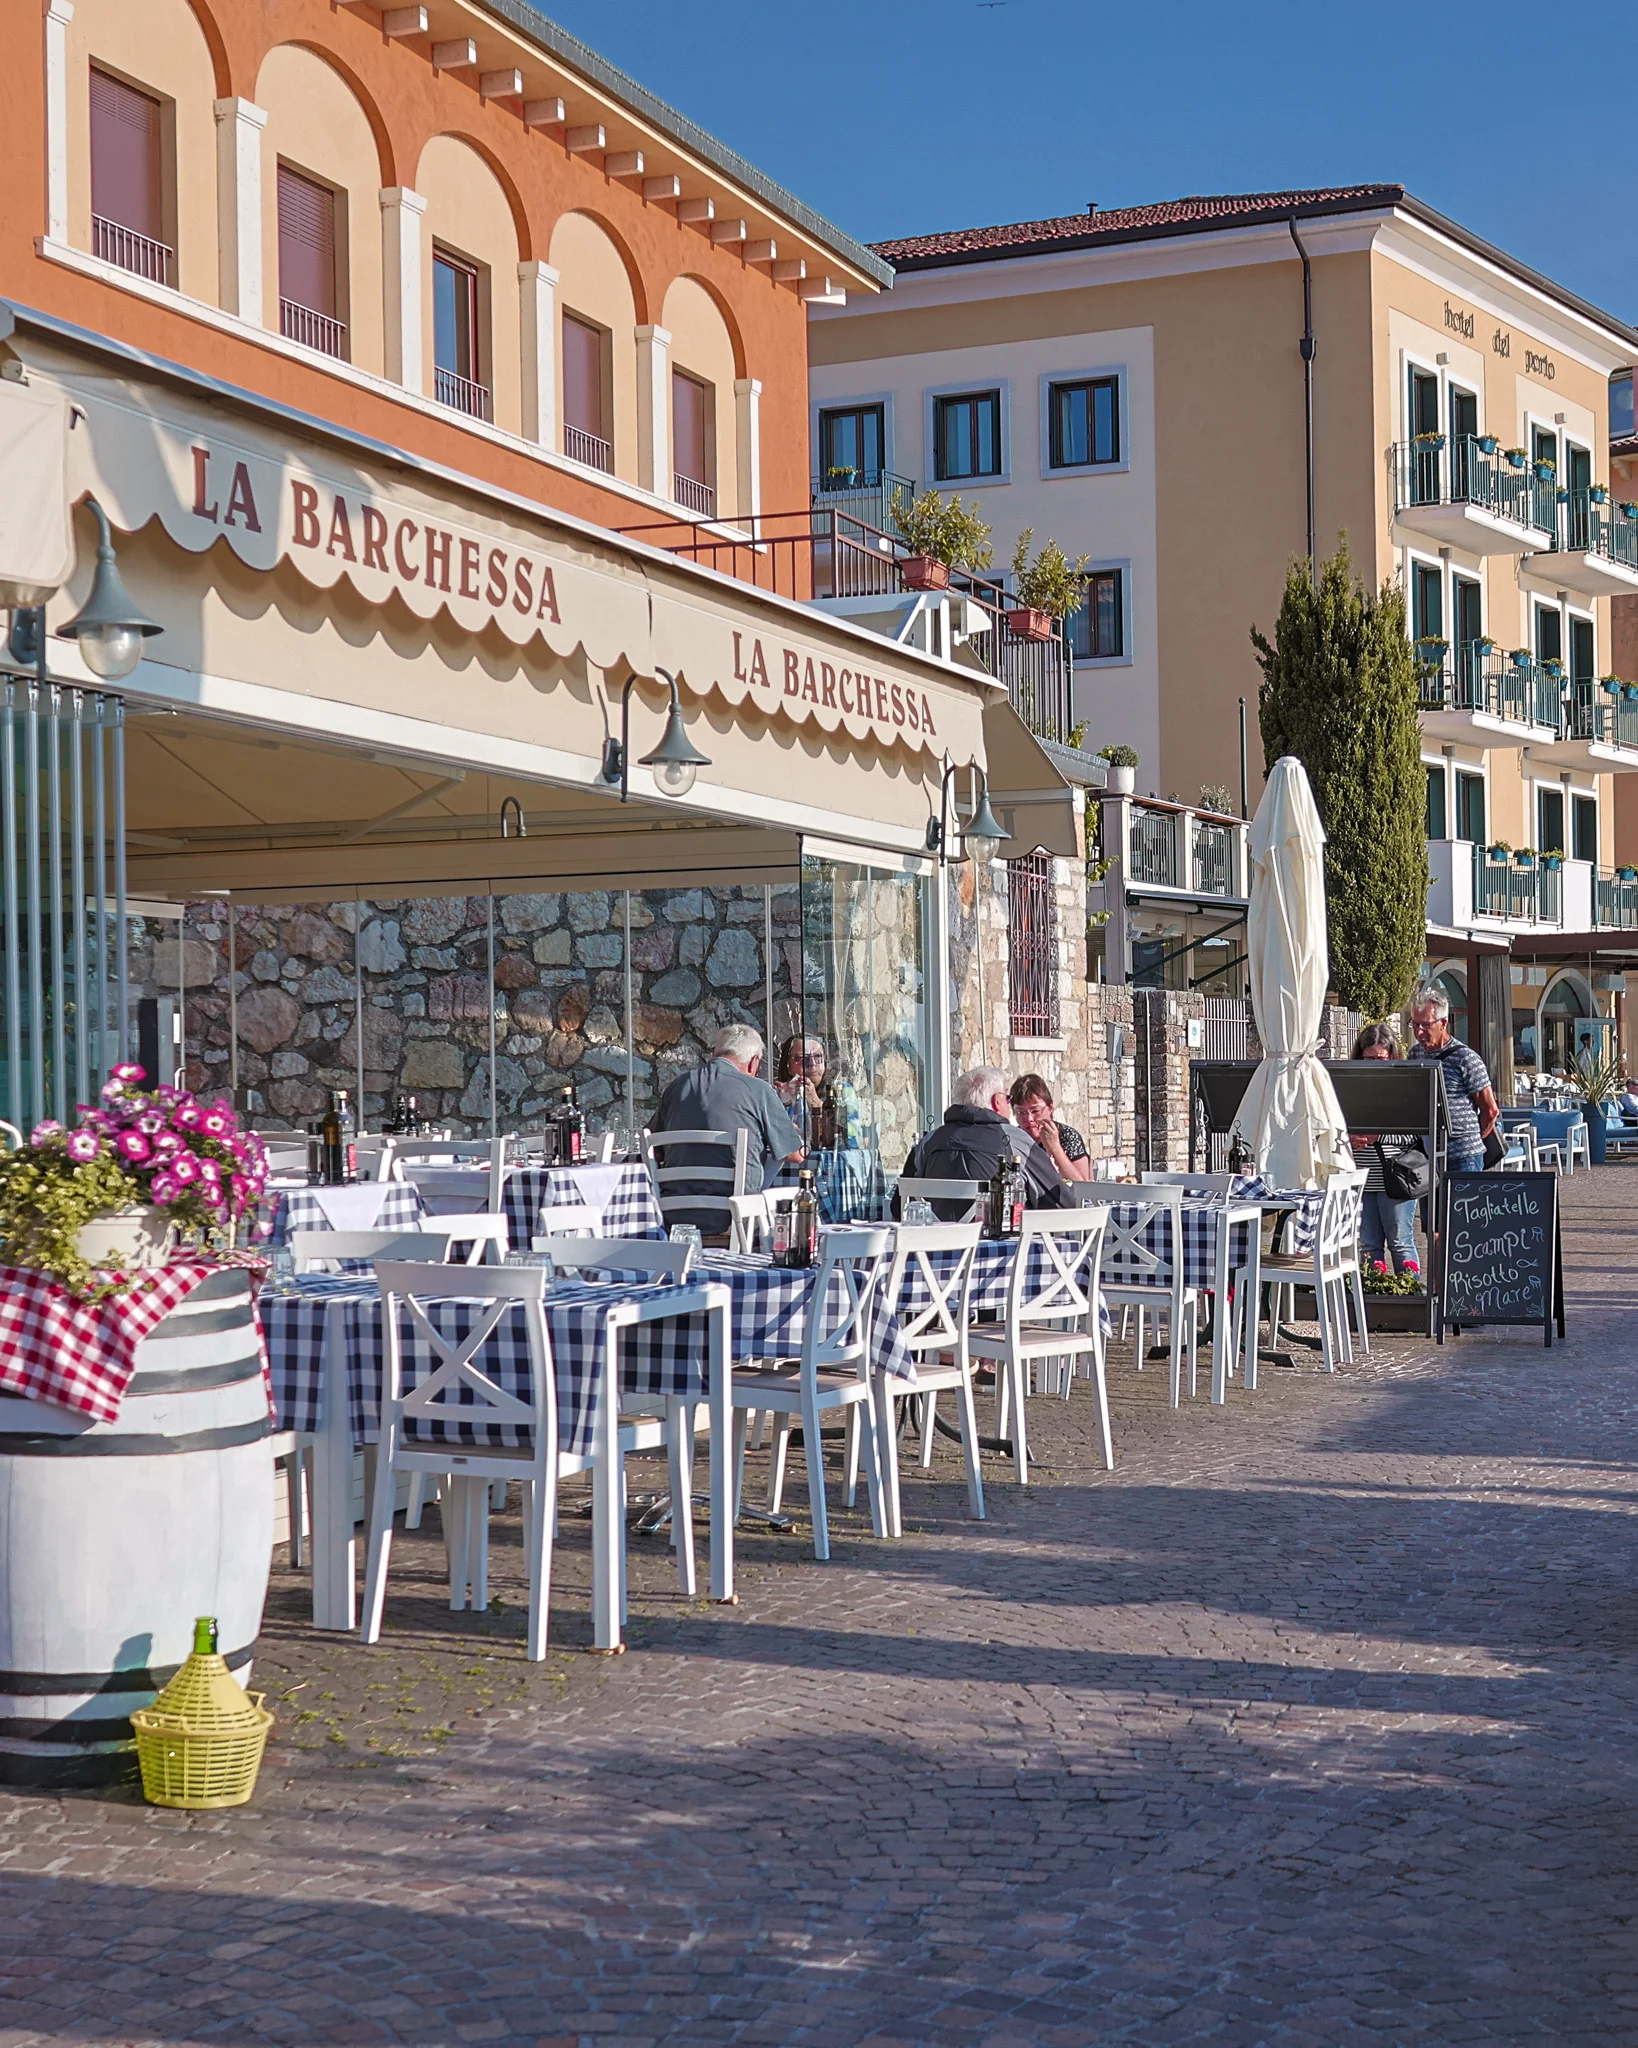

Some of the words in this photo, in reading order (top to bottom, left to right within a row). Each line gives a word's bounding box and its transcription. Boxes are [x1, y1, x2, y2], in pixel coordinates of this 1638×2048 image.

[1444, 300, 1474, 339] hotel
[1492, 328, 1510, 358] del
[1525, 349, 1555, 380] porto
[191, 445, 262, 533] LA
[290, 478, 561, 624] BARCHESSA
[732, 630, 770, 688] LA
[783, 648, 936, 736] BARCHESSA
[1453, 1192, 1540, 1228] Tagliatelle
[1453, 1228, 1531, 1263] Scampi
[1449, 1263, 1519, 1295] Risotto
